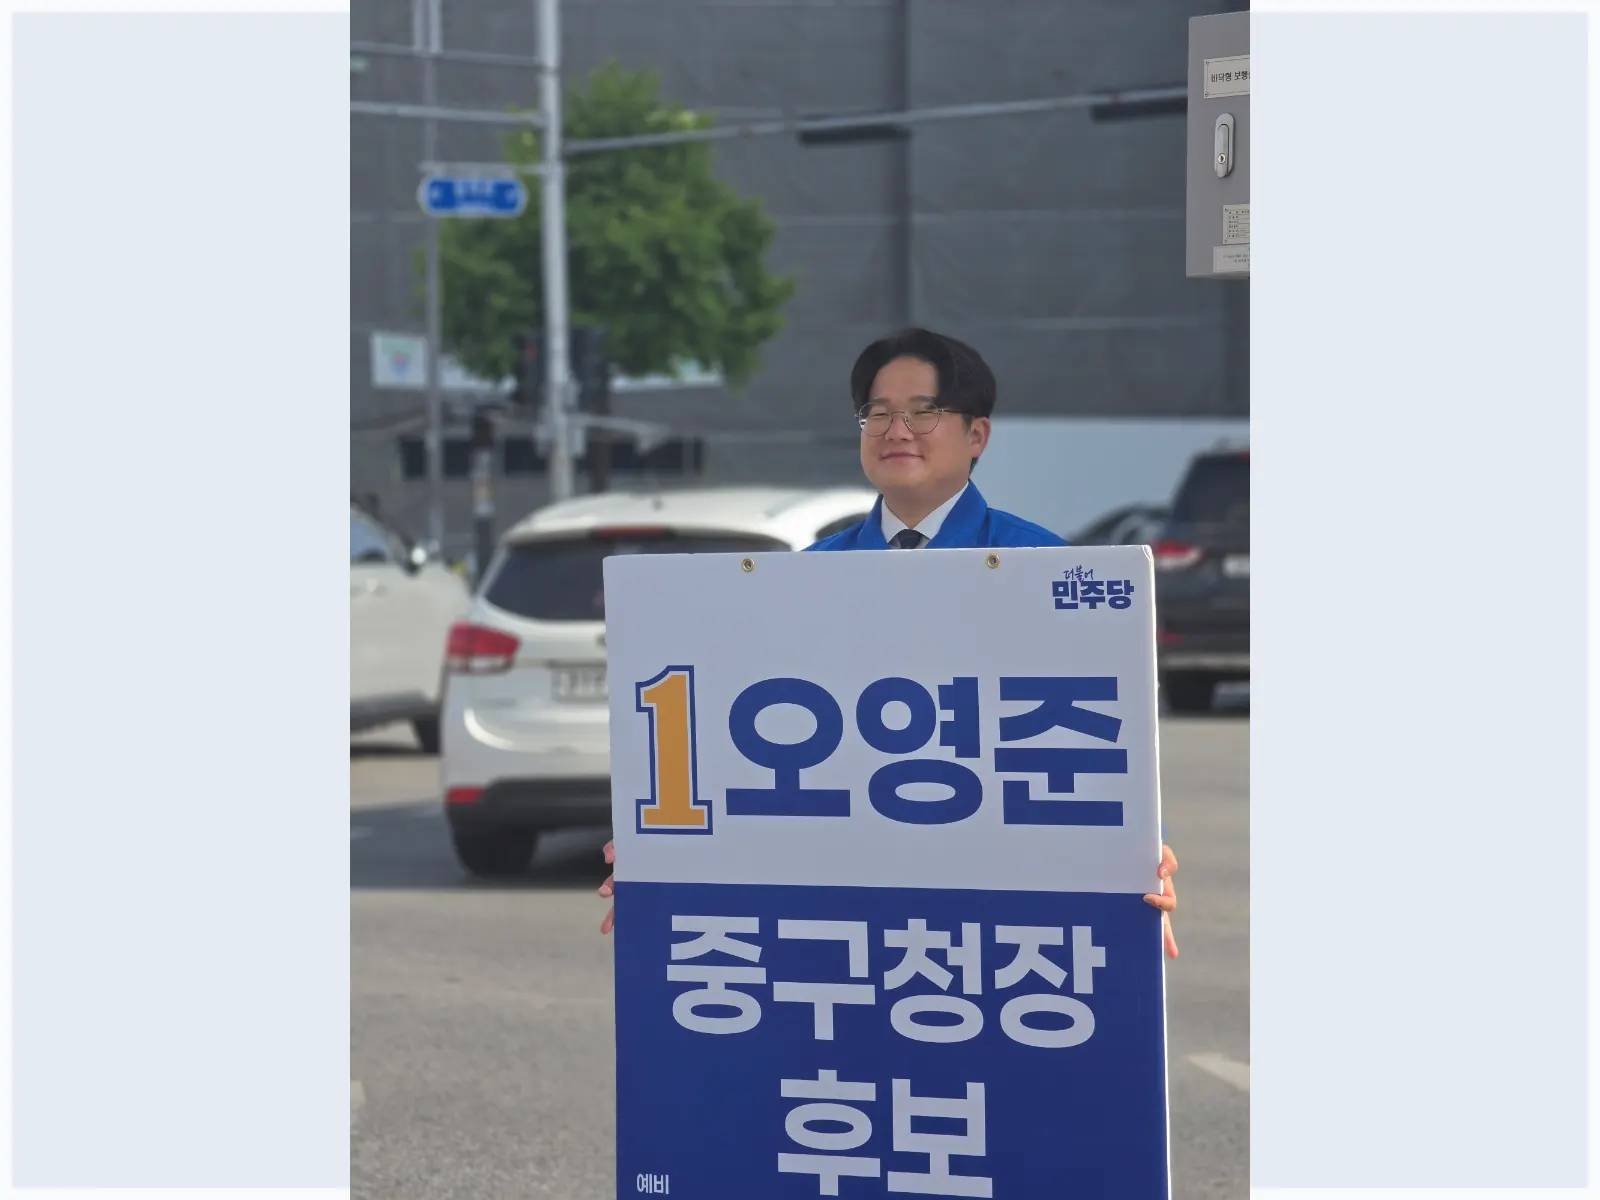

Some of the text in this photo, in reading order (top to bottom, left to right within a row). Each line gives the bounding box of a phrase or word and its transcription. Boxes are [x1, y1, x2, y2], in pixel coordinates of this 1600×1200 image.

[1234, 70, 1250, 81] 보행
[1063, 564, 1094, 582] 더불어
[1052, 580, 1135, 610] 민주당
[636, 664, 1128, 835] 1 오영준
[666, 914, 1106, 1049] 중구청장
[777, 1068, 994, 1199] 후보
[636, 1173, 669, 1195] 예비
